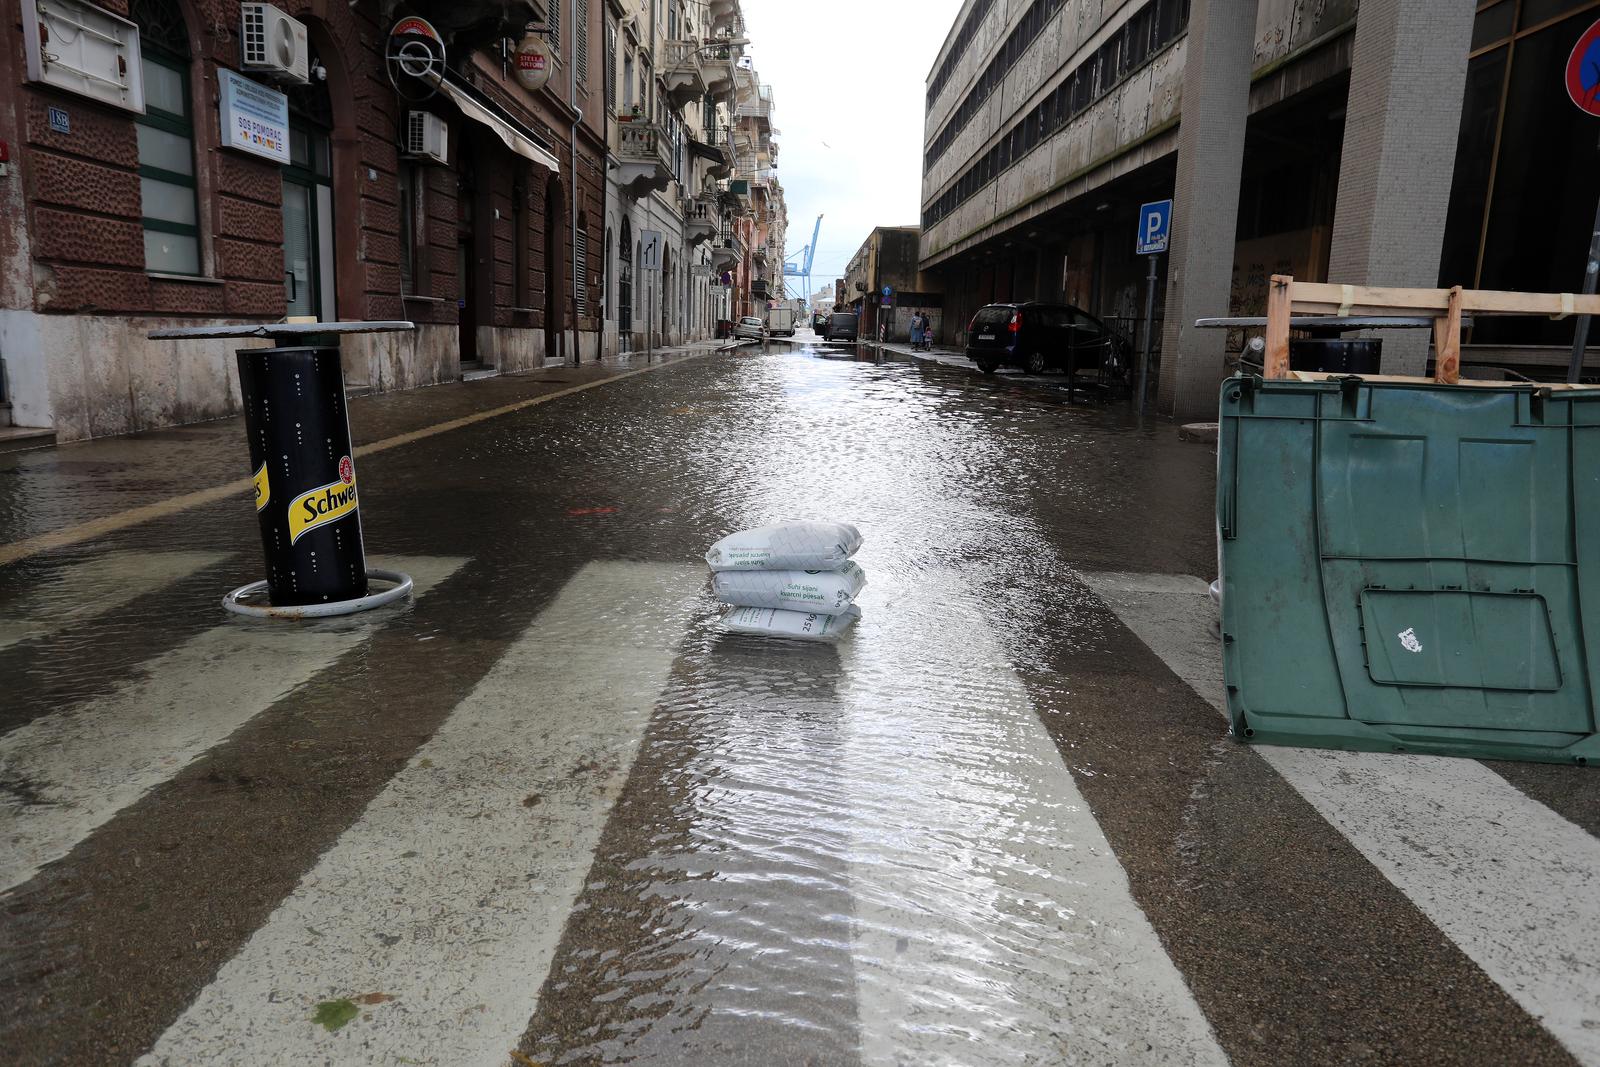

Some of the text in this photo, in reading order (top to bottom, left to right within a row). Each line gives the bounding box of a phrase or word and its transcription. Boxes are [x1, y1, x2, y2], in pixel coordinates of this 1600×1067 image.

[520, 55, 544, 63] STELLA
[238, 116, 282, 141] SOS POMORAC
[1146, 212, 1162, 244] P
[802, 613, 818, 633] 25 kg
